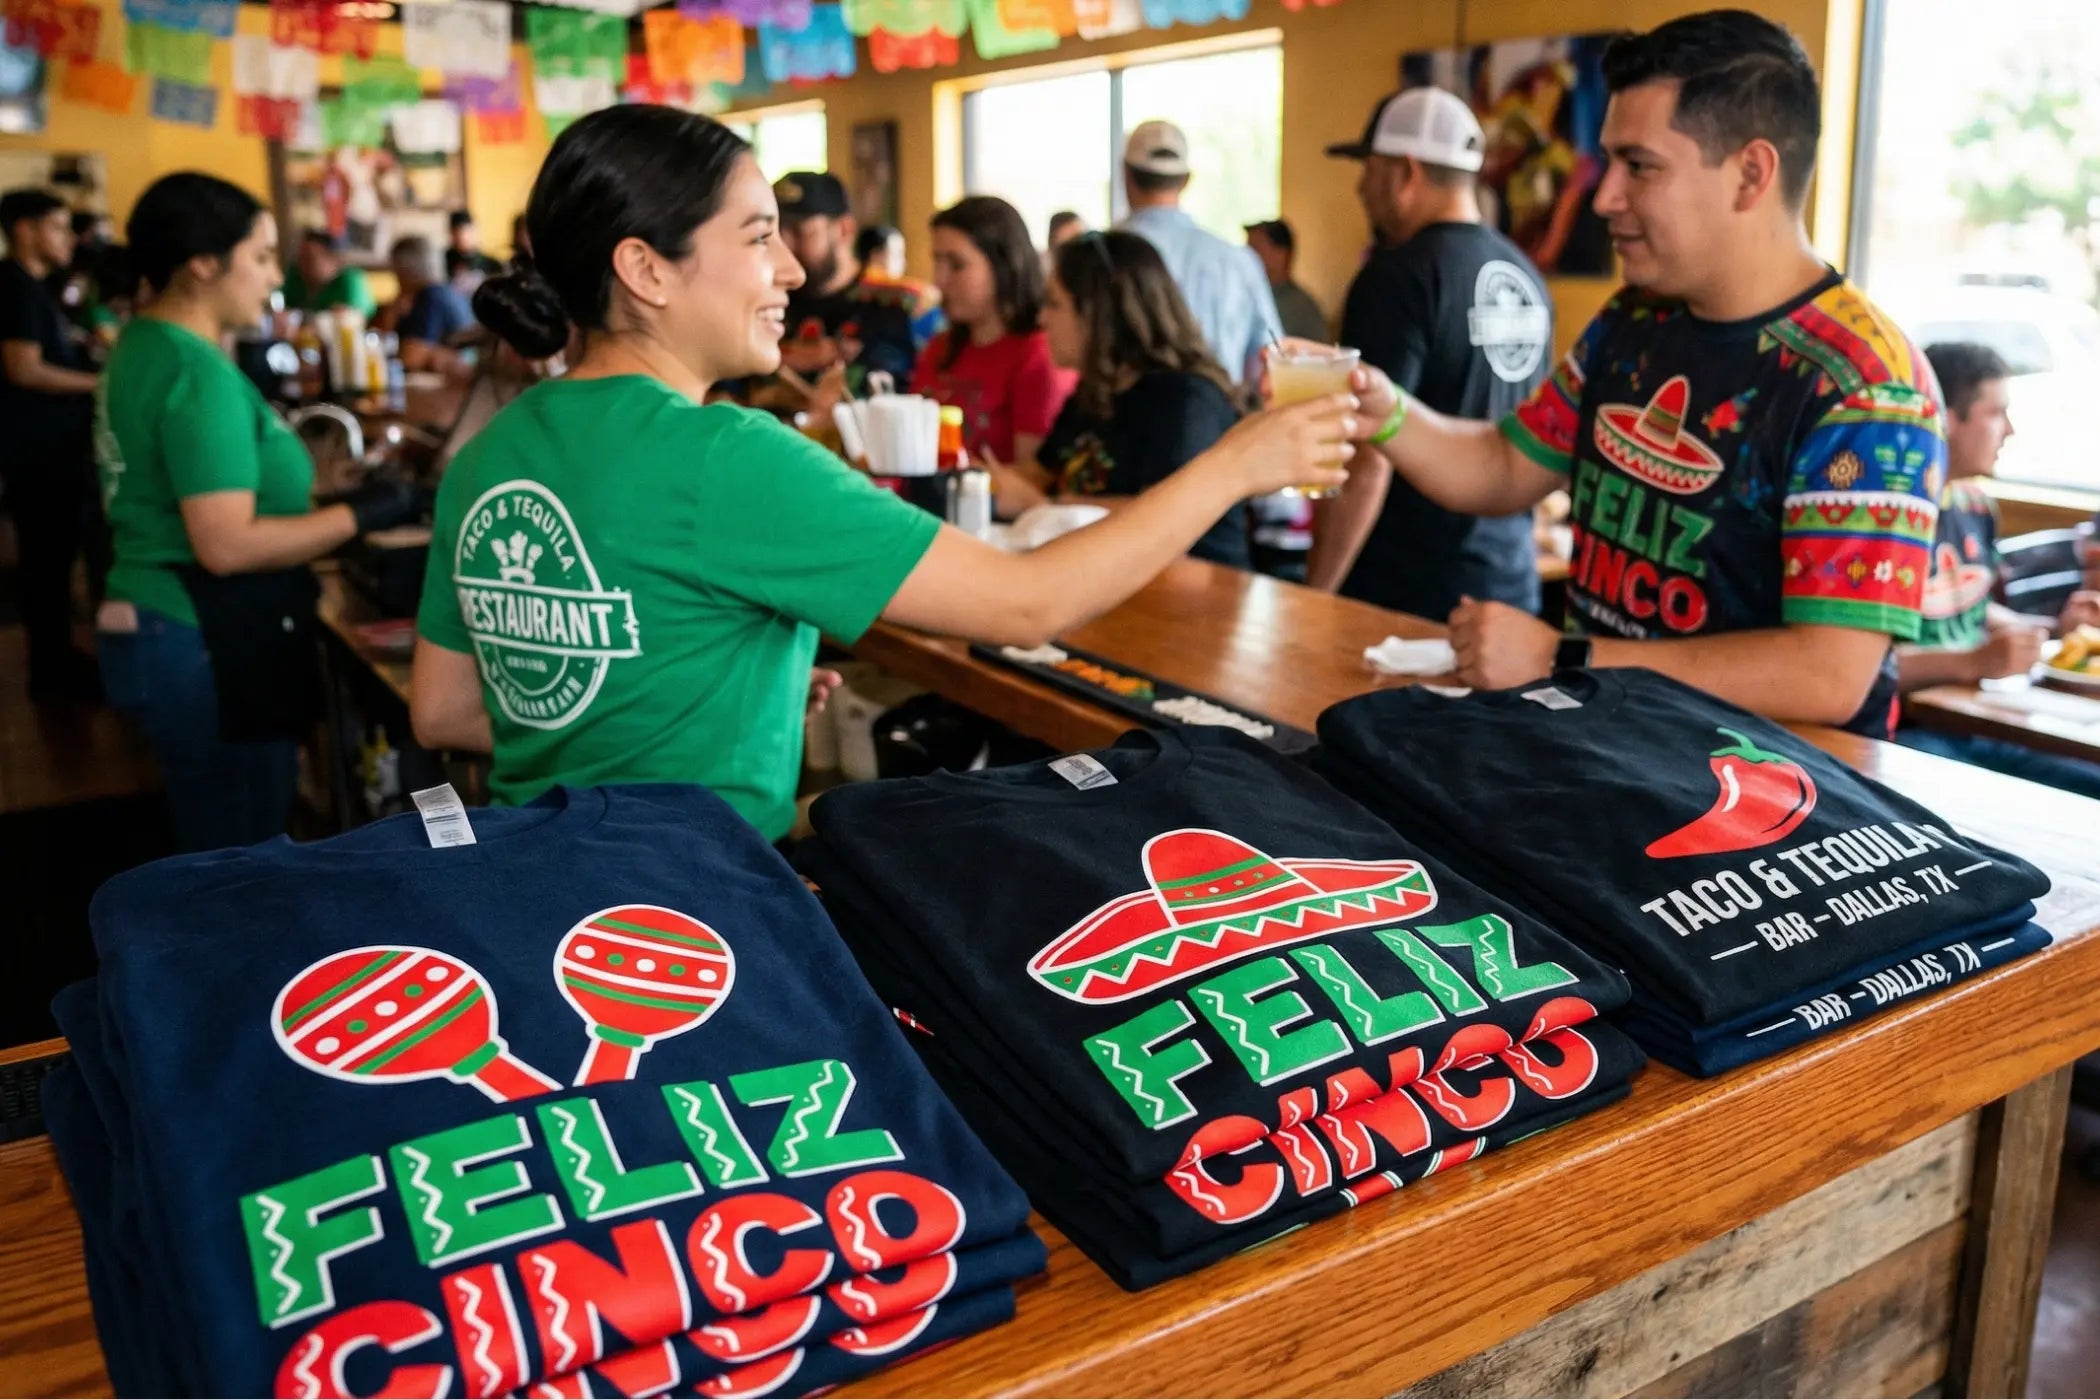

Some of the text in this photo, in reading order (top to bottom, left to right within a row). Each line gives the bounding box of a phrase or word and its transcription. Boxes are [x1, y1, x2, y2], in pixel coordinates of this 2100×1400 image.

[462, 496, 575, 573] TACO & TEQUILA
[1573, 459, 1714, 578] FELIZ
[1640, 821, 1943, 937] TACO & TEQUILA
[1755, 911, 1818, 952] BAR
[1825, 876, 1929, 926] DALLAS,
[1913, 864, 1960, 896] TX
[1084, 913, 1579, 1130] FELIZ
[1793, 993, 1852, 1031] BAR
[1859, 953, 1953, 1005] DALLAS,
[1943, 942, 1981, 971] TX
[1163, 996, 1599, 1225] CINCO
[240, 1058, 904, 1328] FELIZ
[274, 1170, 966, 1399] CINCO
